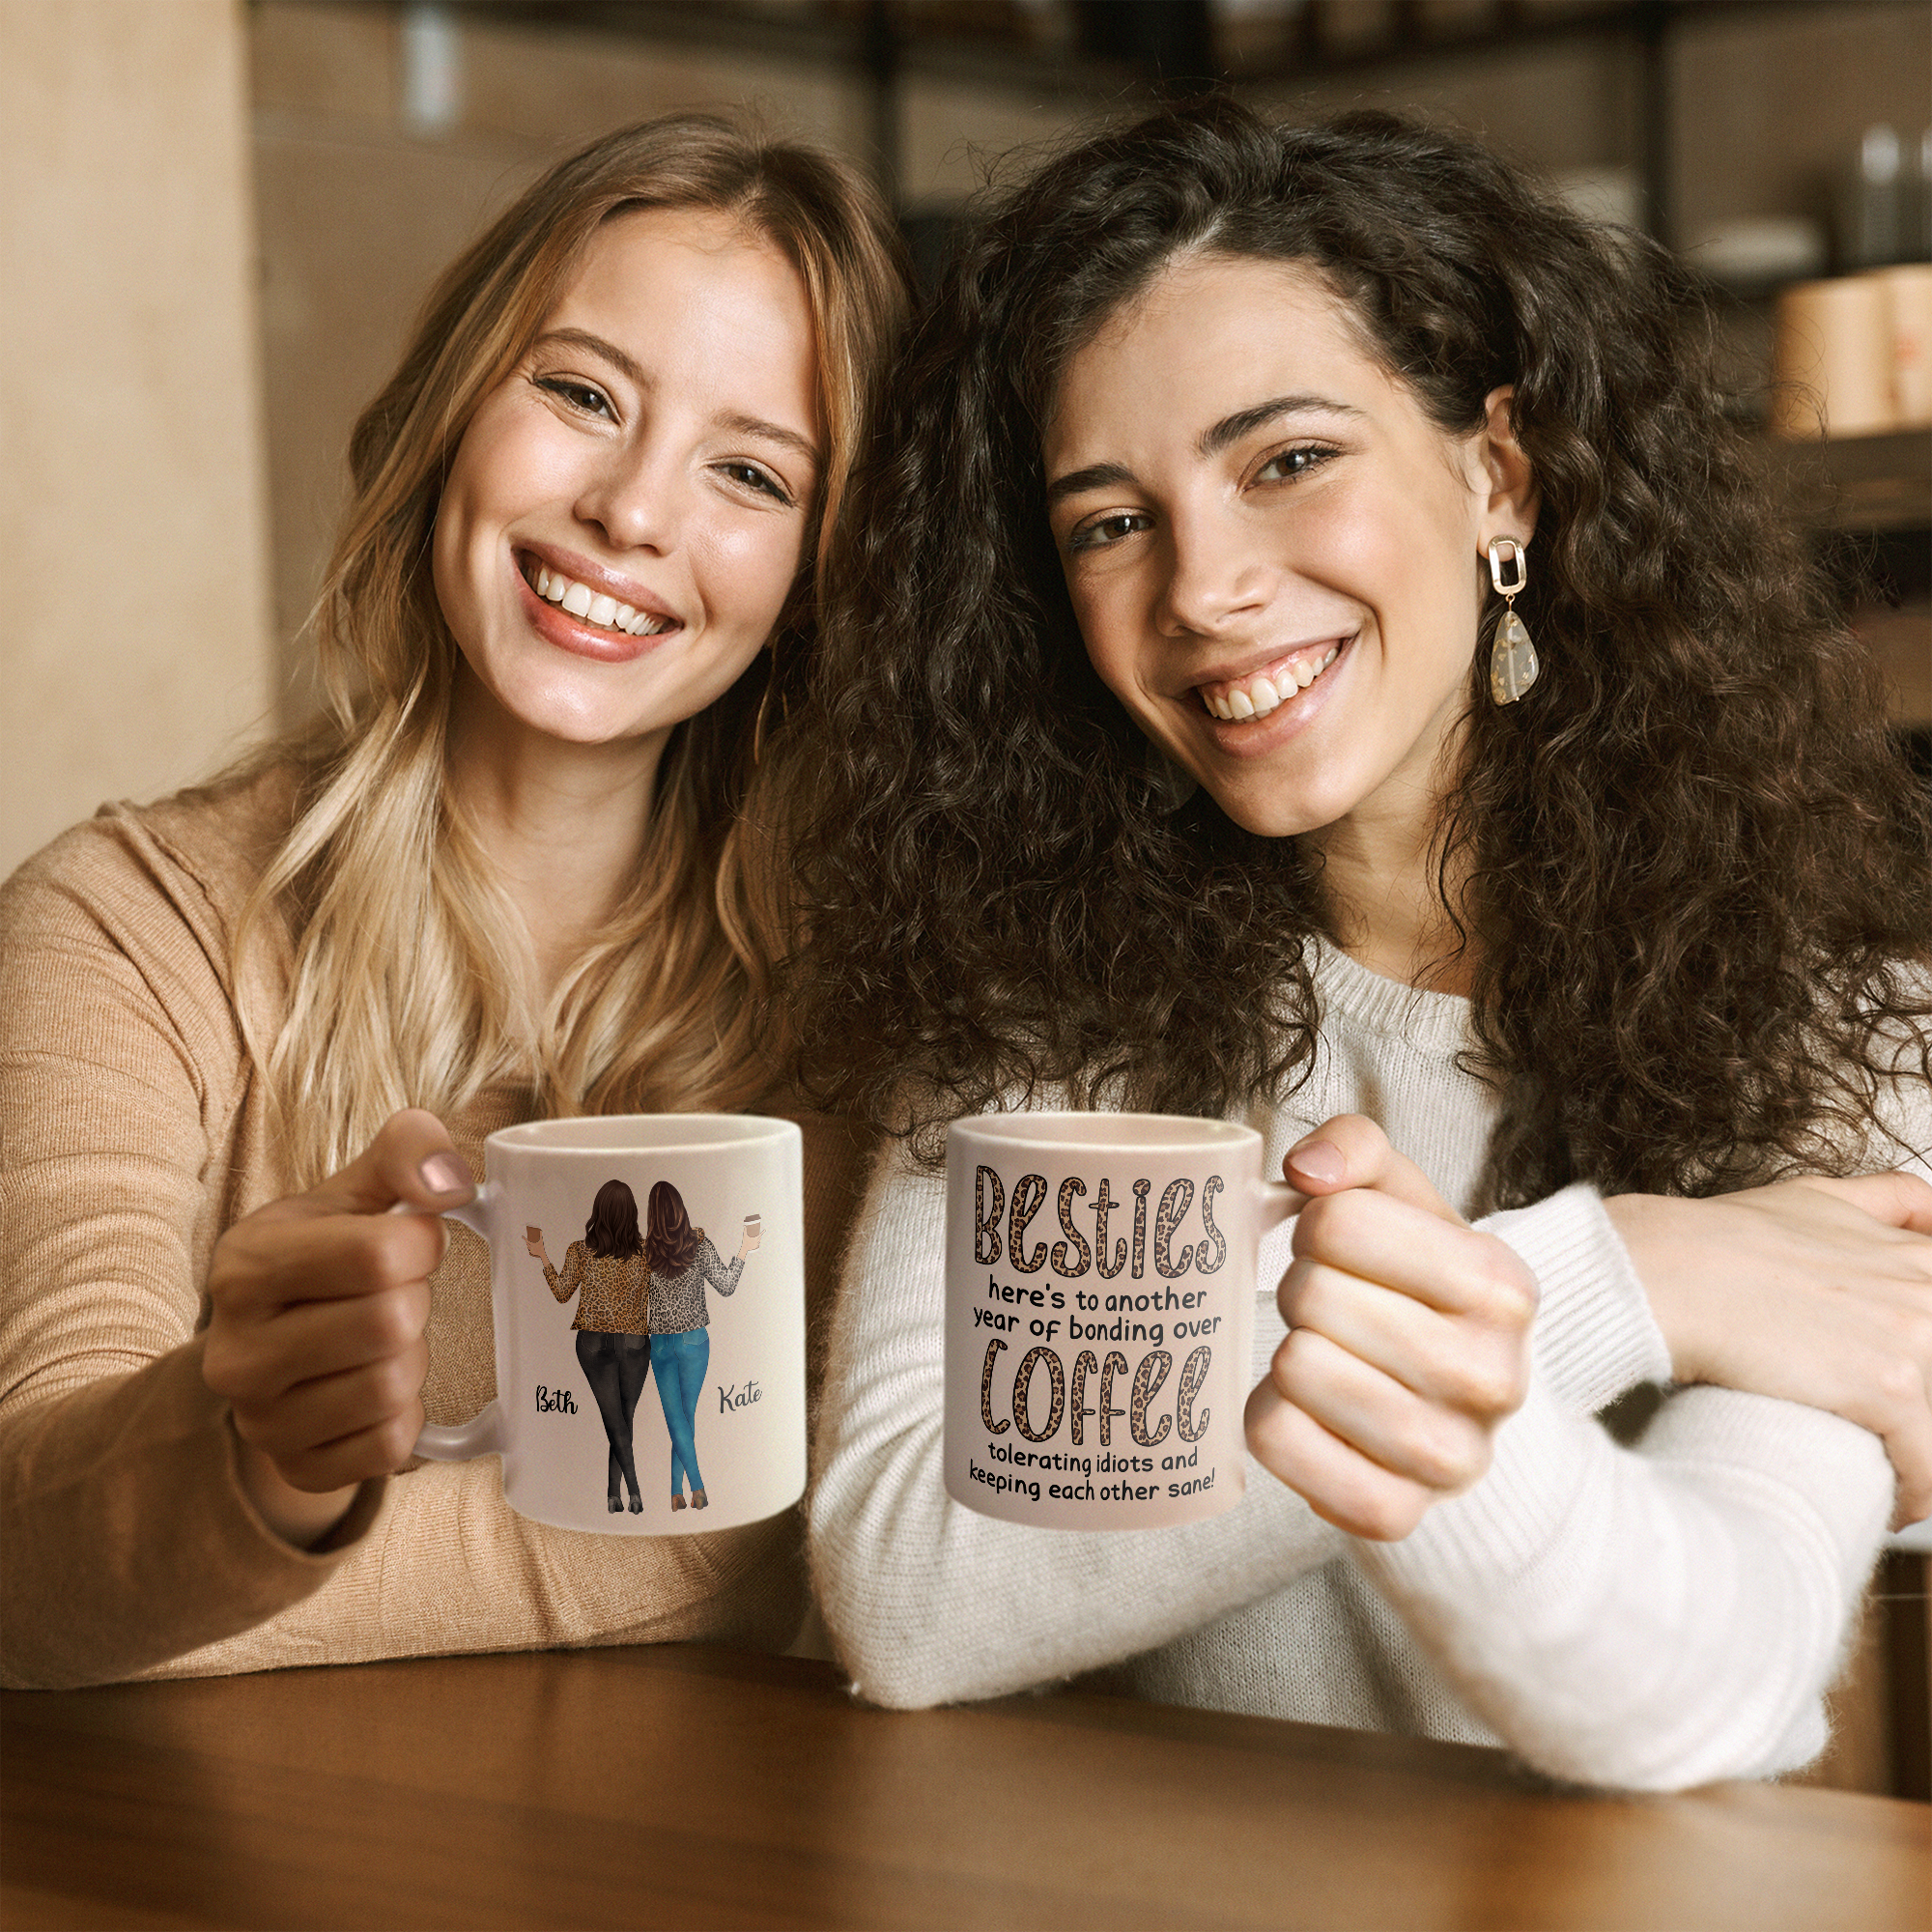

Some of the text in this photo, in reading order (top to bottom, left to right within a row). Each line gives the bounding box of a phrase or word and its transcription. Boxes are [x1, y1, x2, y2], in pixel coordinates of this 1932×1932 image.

[989, 1274, 1207, 1312] here's to another
[974, 1307, 1221, 1347] year of bonding over
[536, 1385, 578, 1414] Beth
[718, 1380, 762, 1413] Kate
[988, 1442, 1197, 1477] tolerating idiots and
[970, 1459, 1214, 1501] keeping each other sane!
